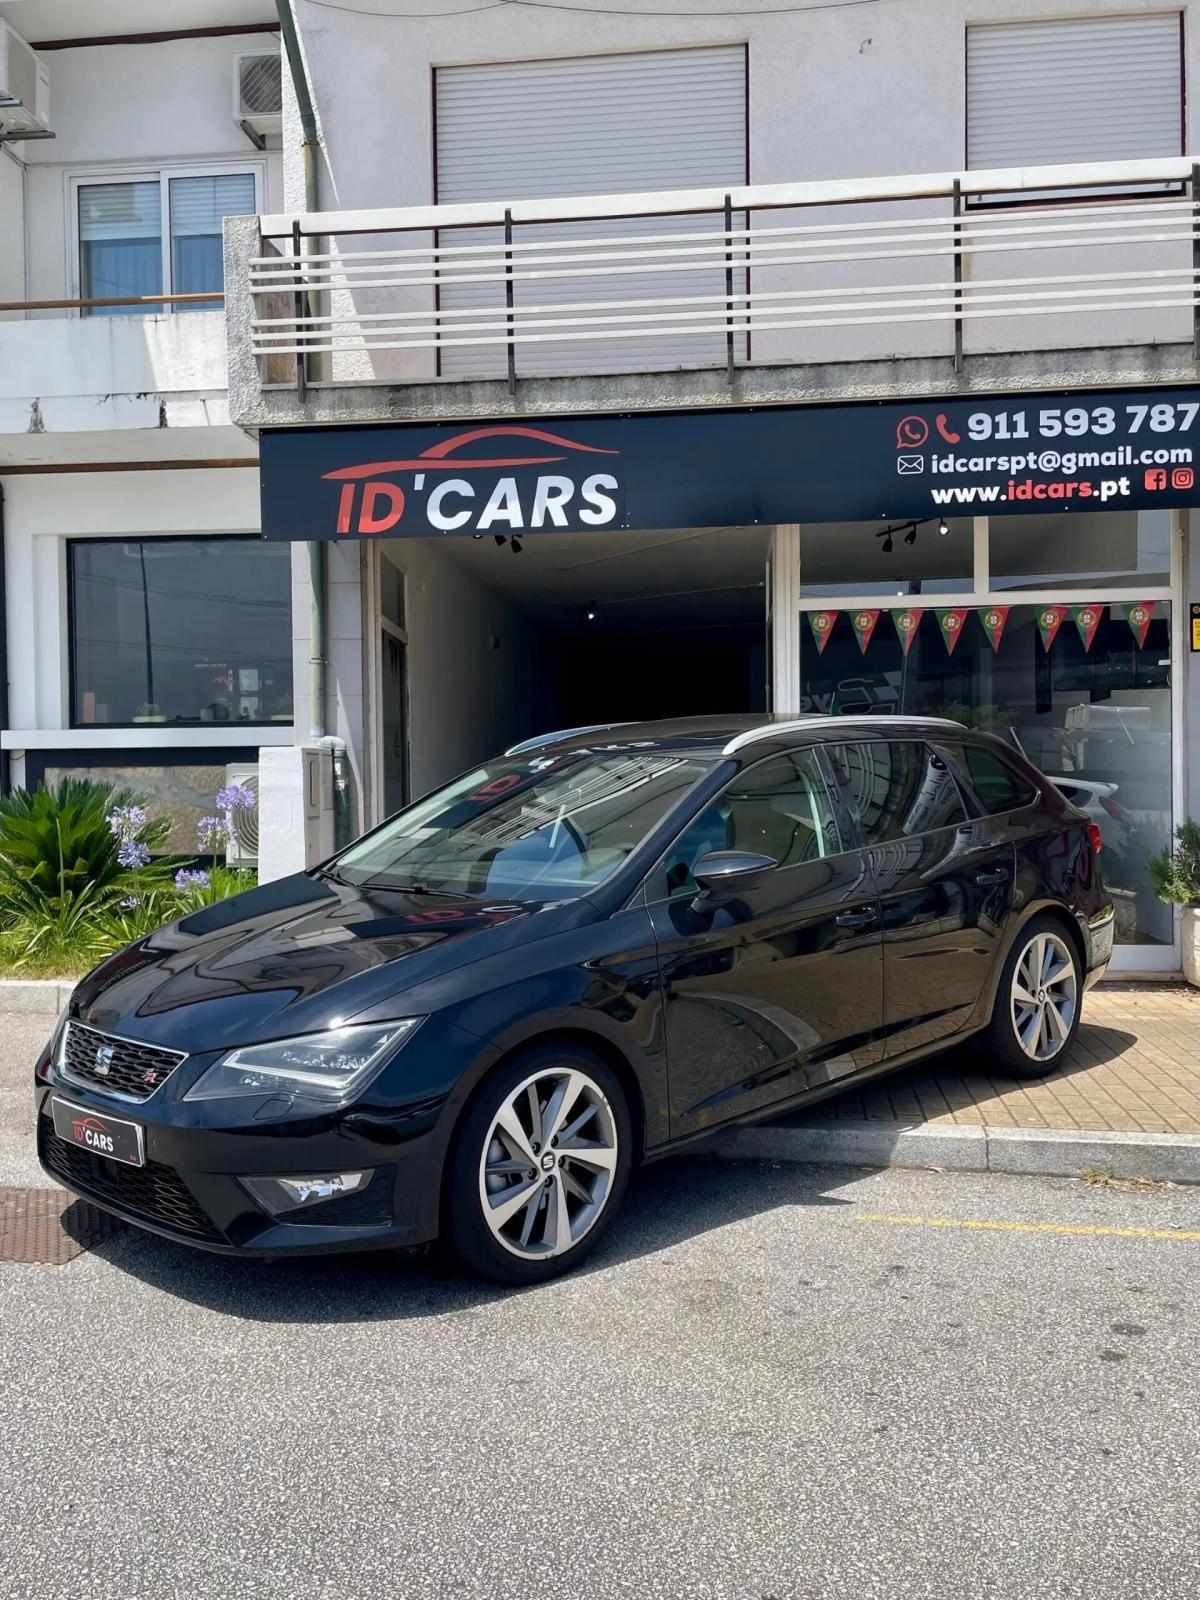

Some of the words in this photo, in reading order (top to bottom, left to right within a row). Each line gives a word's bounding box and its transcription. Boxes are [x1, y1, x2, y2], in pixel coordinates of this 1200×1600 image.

[967, 412, 1030, 441] 911
[1039, 407, 1117, 437] 593
[1126, 403, 1200, 434] 787
[931, 446, 1193, 475] idcarspt@gmail.com
[931, 477, 1131, 504] www.idcars.pt
